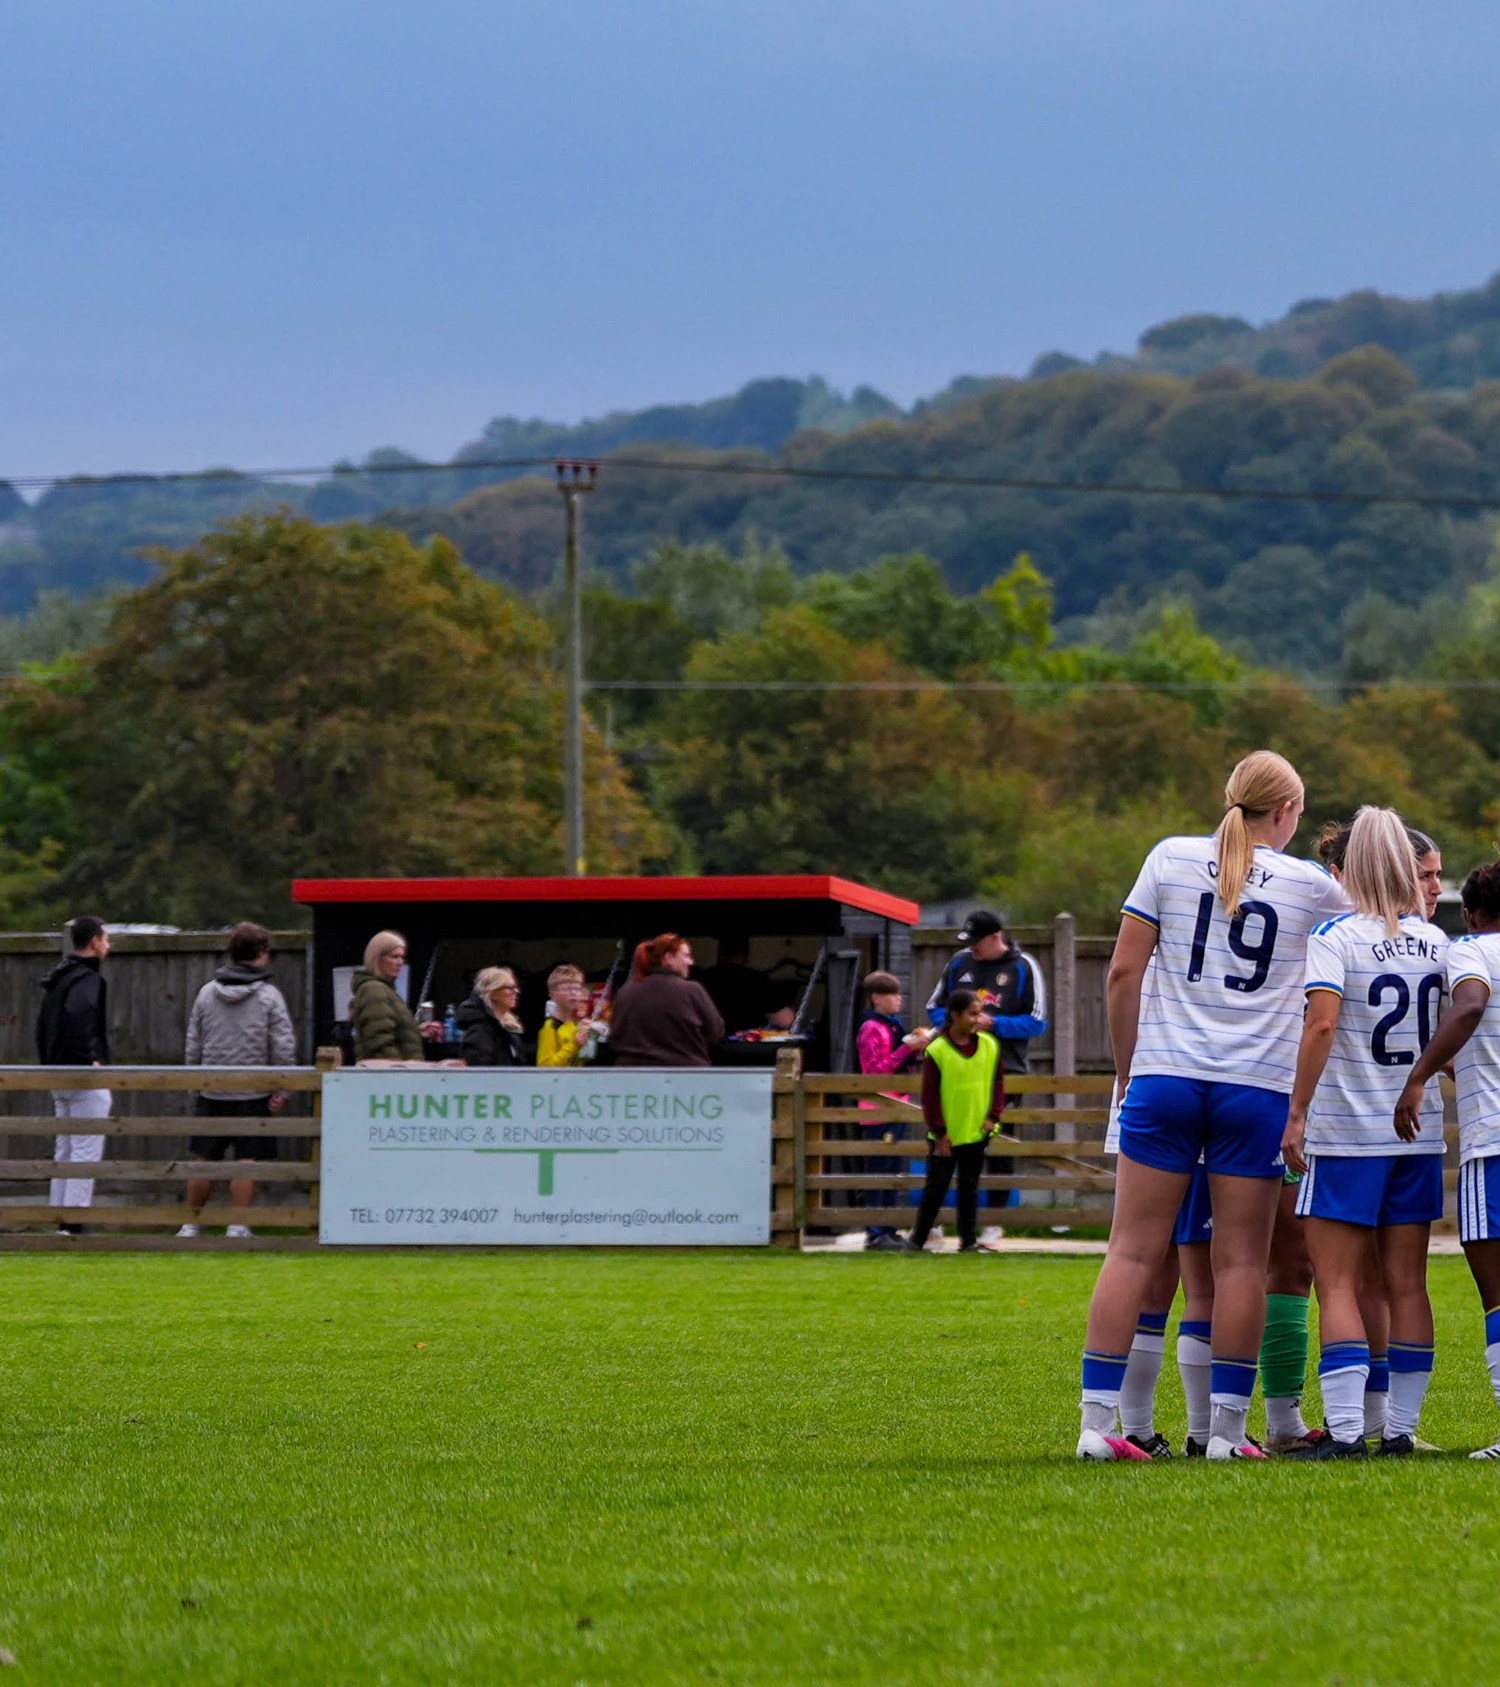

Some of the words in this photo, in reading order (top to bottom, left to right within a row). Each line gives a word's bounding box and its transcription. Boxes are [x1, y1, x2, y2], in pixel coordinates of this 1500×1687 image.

[1187, 892, 1278, 992] 19
[1372, 937, 1438, 962] GREENE
[1368, 973, 1443, 1066] 20
[370, 1095, 511, 1118] HUNTER
[532, 1095, 722, 1119] PLASTERING
[369, 1127, 476, 1142] PLASTERING
[483, 1127, 496, 1142] &
[503, 1127, 611, 1143] RENDERING
[619, 1127, 723, 1143] SOLUTIONS
[350, 1208, 379, 1223] TEL:
[385, 1208, 434, 1223] 07732
[440, 1208, 498, 1223] 394007
[514, 1209, 738, 1227] hunterplastering@outlook.com
